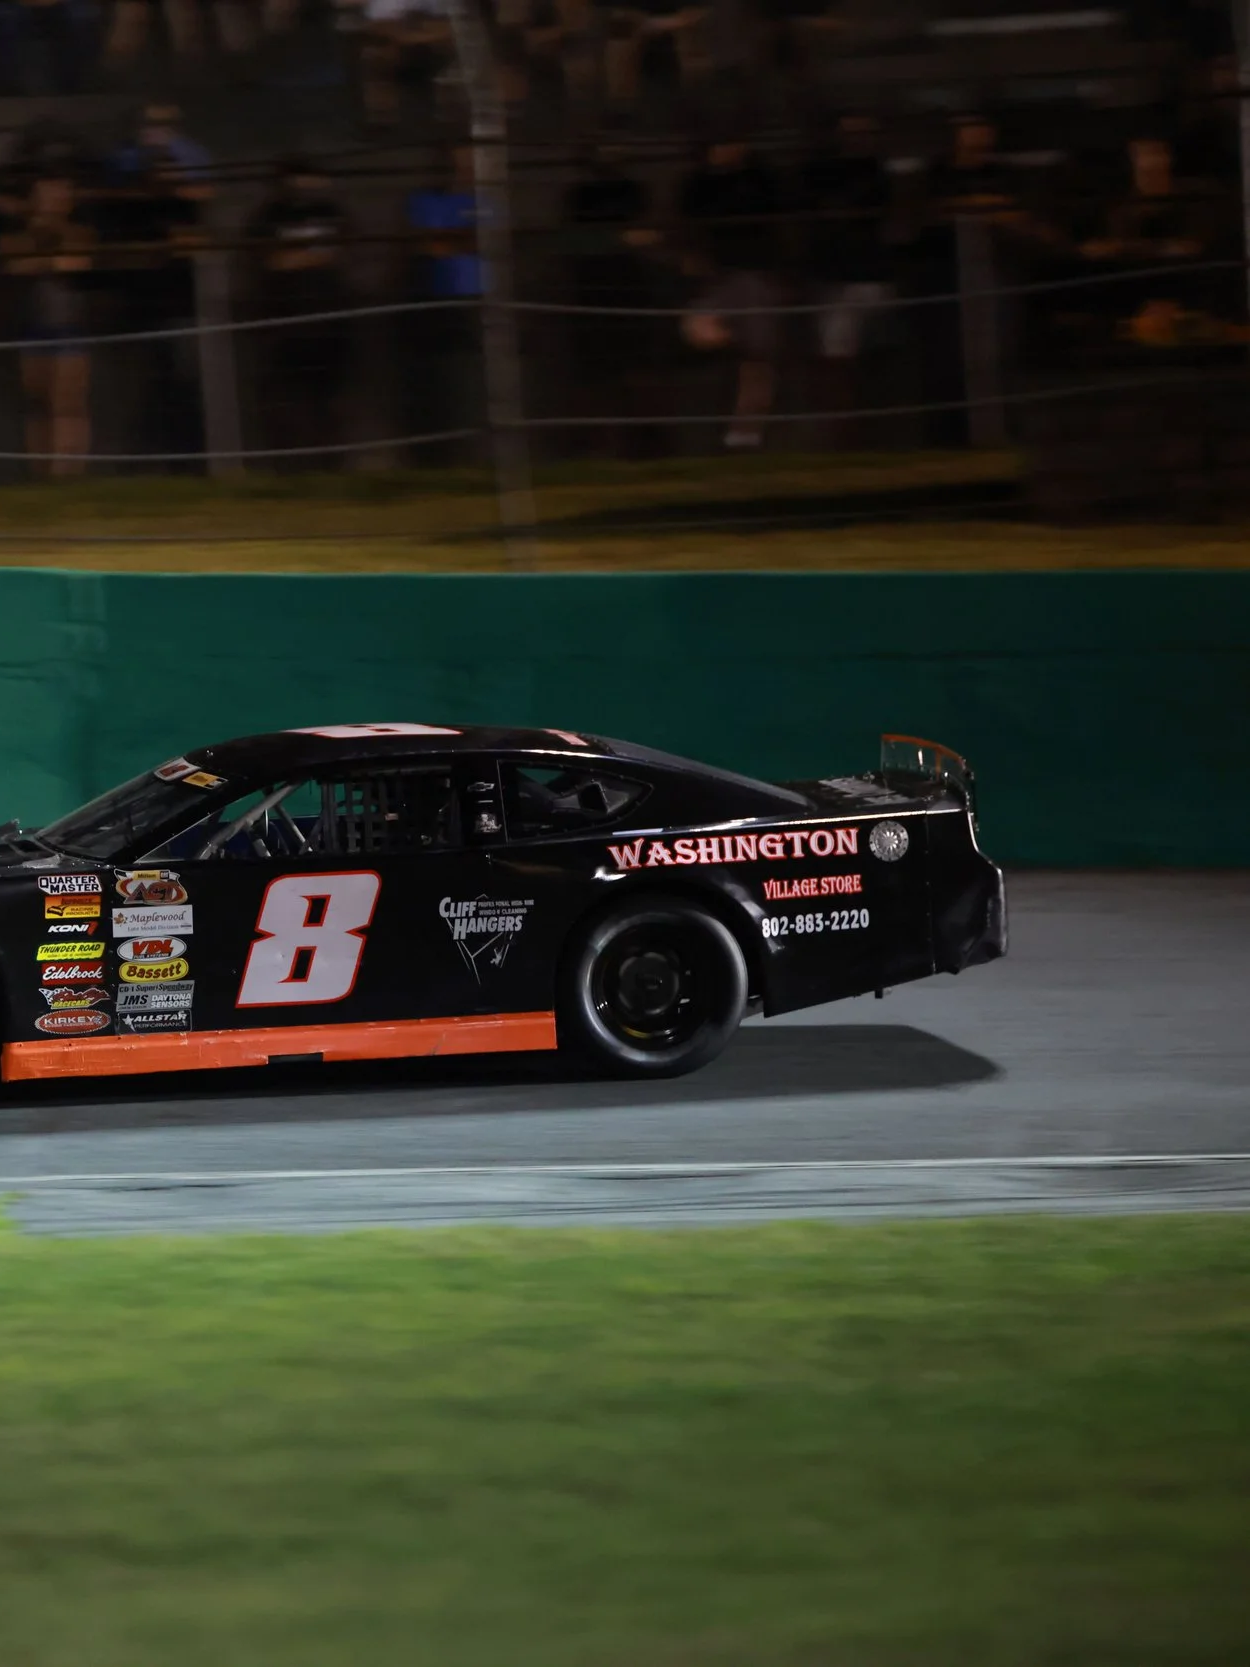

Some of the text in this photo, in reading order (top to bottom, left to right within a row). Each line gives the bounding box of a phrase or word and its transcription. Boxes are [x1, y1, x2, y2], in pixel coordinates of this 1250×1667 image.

[607, 828, 859, 870] WASHINGTON
[39, 876, 97, 889] QUARTER
[50, 884, 100, 893] MASTER
[763, 874, 863, 900] VILLAGE STORE
[439, 896, 477, 918] CLIFF
[129, 911, 187, 925] Maplewood
[761, 908, 870, 938] 802-883-2220
[48, 924, 90, 933] KONI
[453, 915, 523, 940] HANGERS
[235, 870, 382, 1008] 8
[40, 943, 101, 954] THUNDER ROAD
[42, 965, 103, 980] Edelbrock
[126, 962, 182, 979] Bassett
[119, 994, 149, 1006] JMS
[152, 993, 192, 1002] DAYTONA
[150, 1000, 190, 1009] SENSORS
[44, 1016, 96, 1025] KIRKEY
[133, 1013, 187, 1023] ALLSTAR
